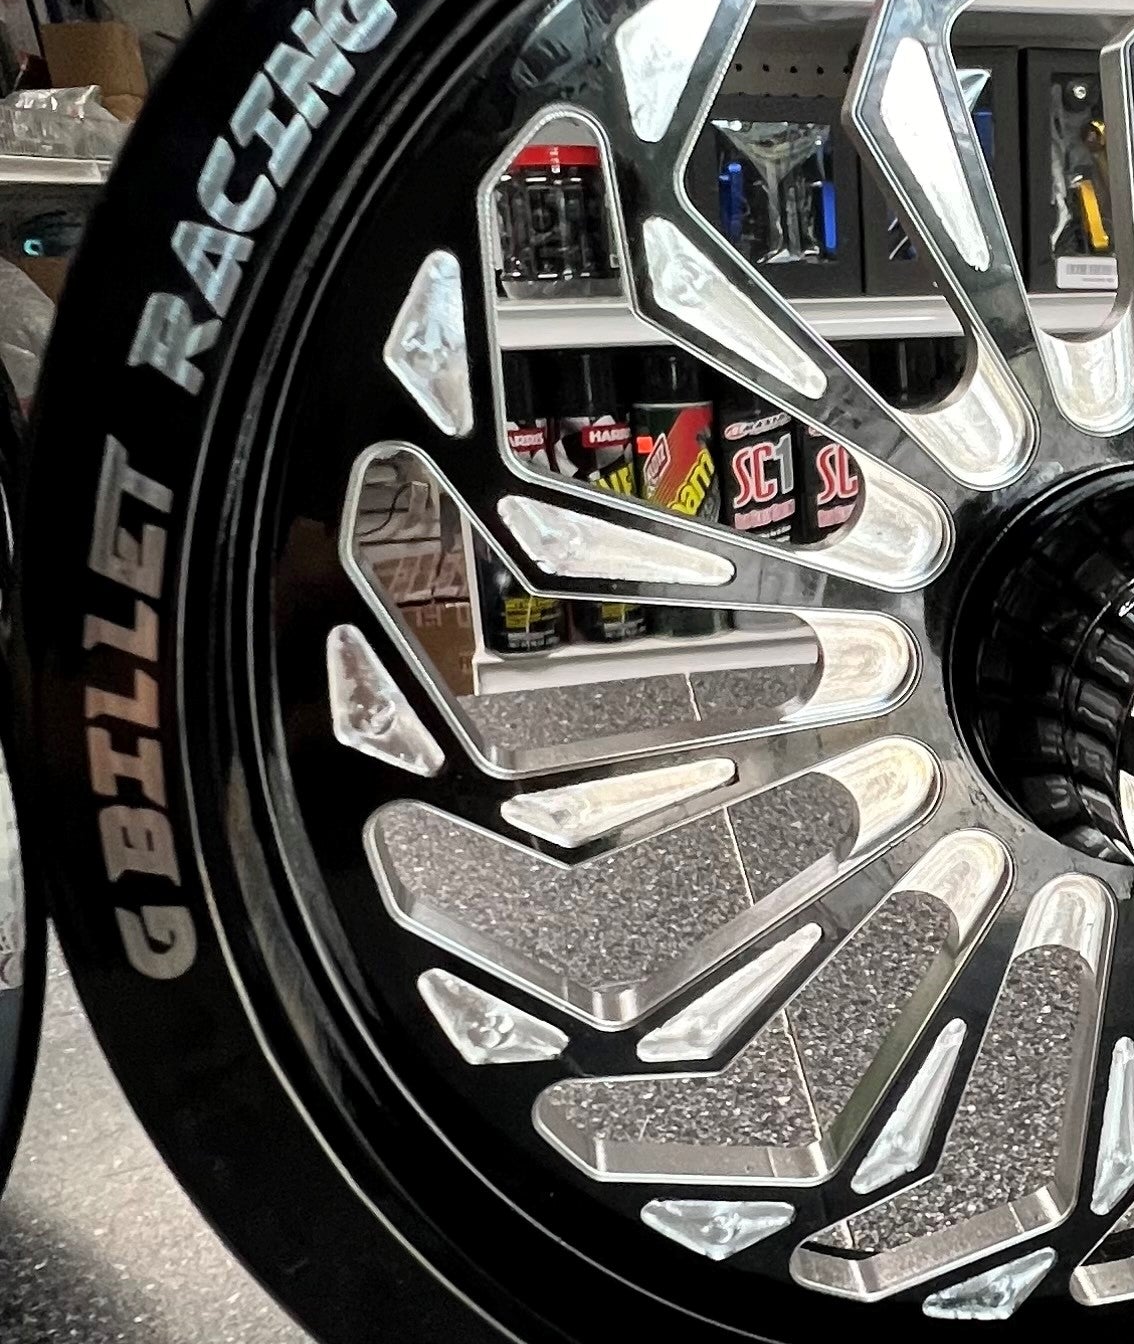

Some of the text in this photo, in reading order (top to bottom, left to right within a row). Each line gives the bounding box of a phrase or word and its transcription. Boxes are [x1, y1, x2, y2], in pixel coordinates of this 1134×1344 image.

[732, 433, 794, 509] SC1
[82, 433, 181, 887] BILLET
[114, 904, 198, 980] G
